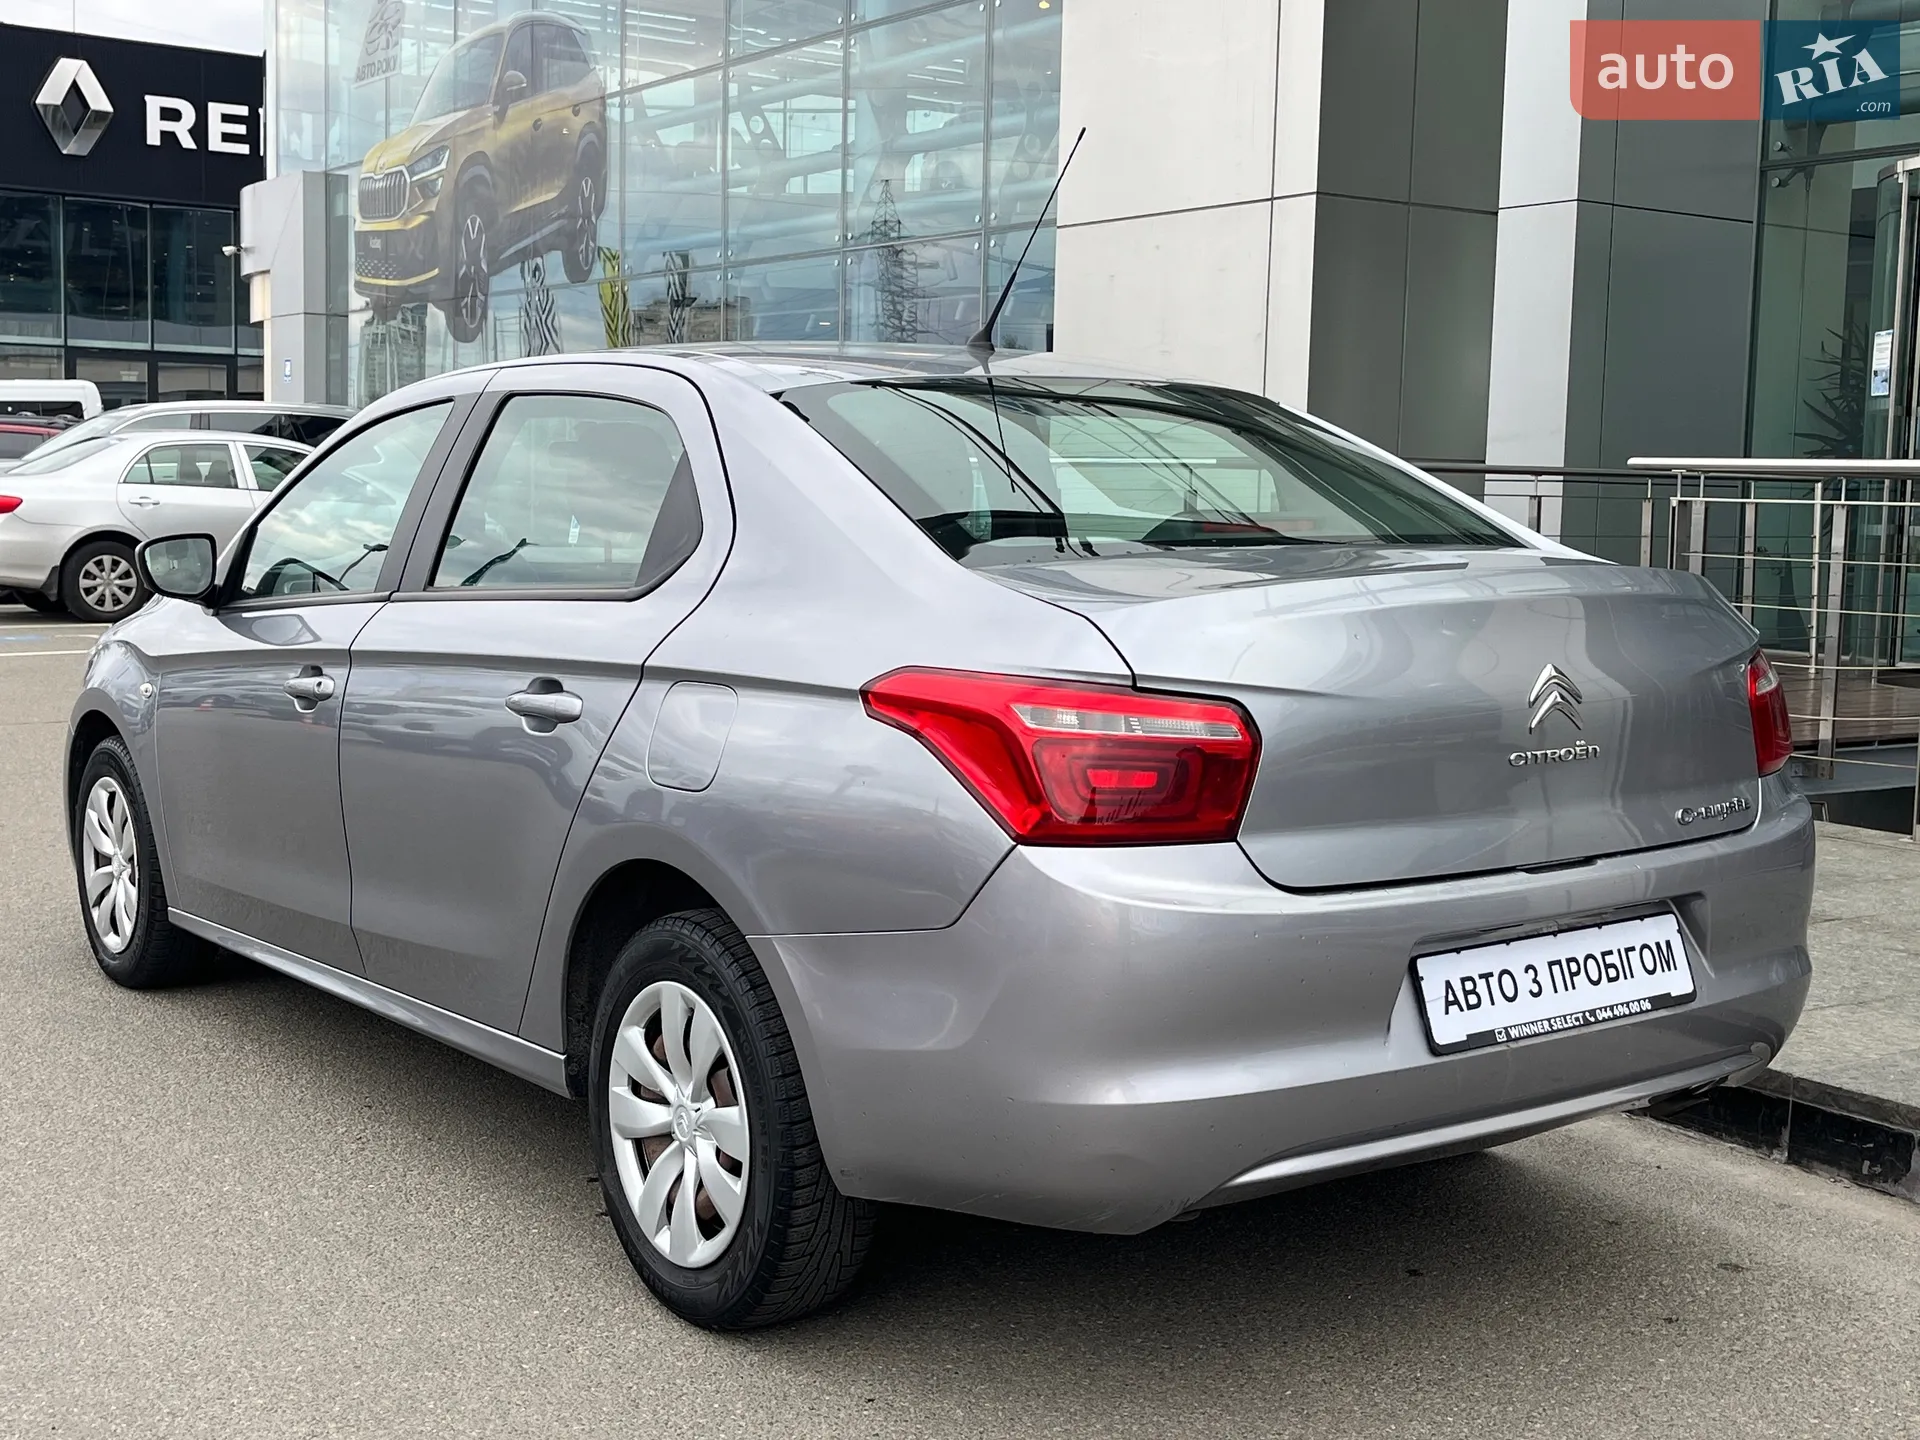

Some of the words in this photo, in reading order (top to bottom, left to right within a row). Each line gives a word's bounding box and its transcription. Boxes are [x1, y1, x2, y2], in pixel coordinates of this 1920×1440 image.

[144, 94, 265, 157] RE
[1444, 968, 1519, 1015] АВТО
[1524, 964, 1543, 998] З
[1547, 940, 1678, 994] ПРОБІГОМ
[1508, 1022, 1551, 1039] WINNER
[1552, 1013, 1585, 1031] SELECT
[1596, 1008, 1613, 1021] 044
[1613, 1003, 1630, 1017] 496
[1630, 1001, 1641, 1013] 00
[1641, 999, 1651, 1011] 06
